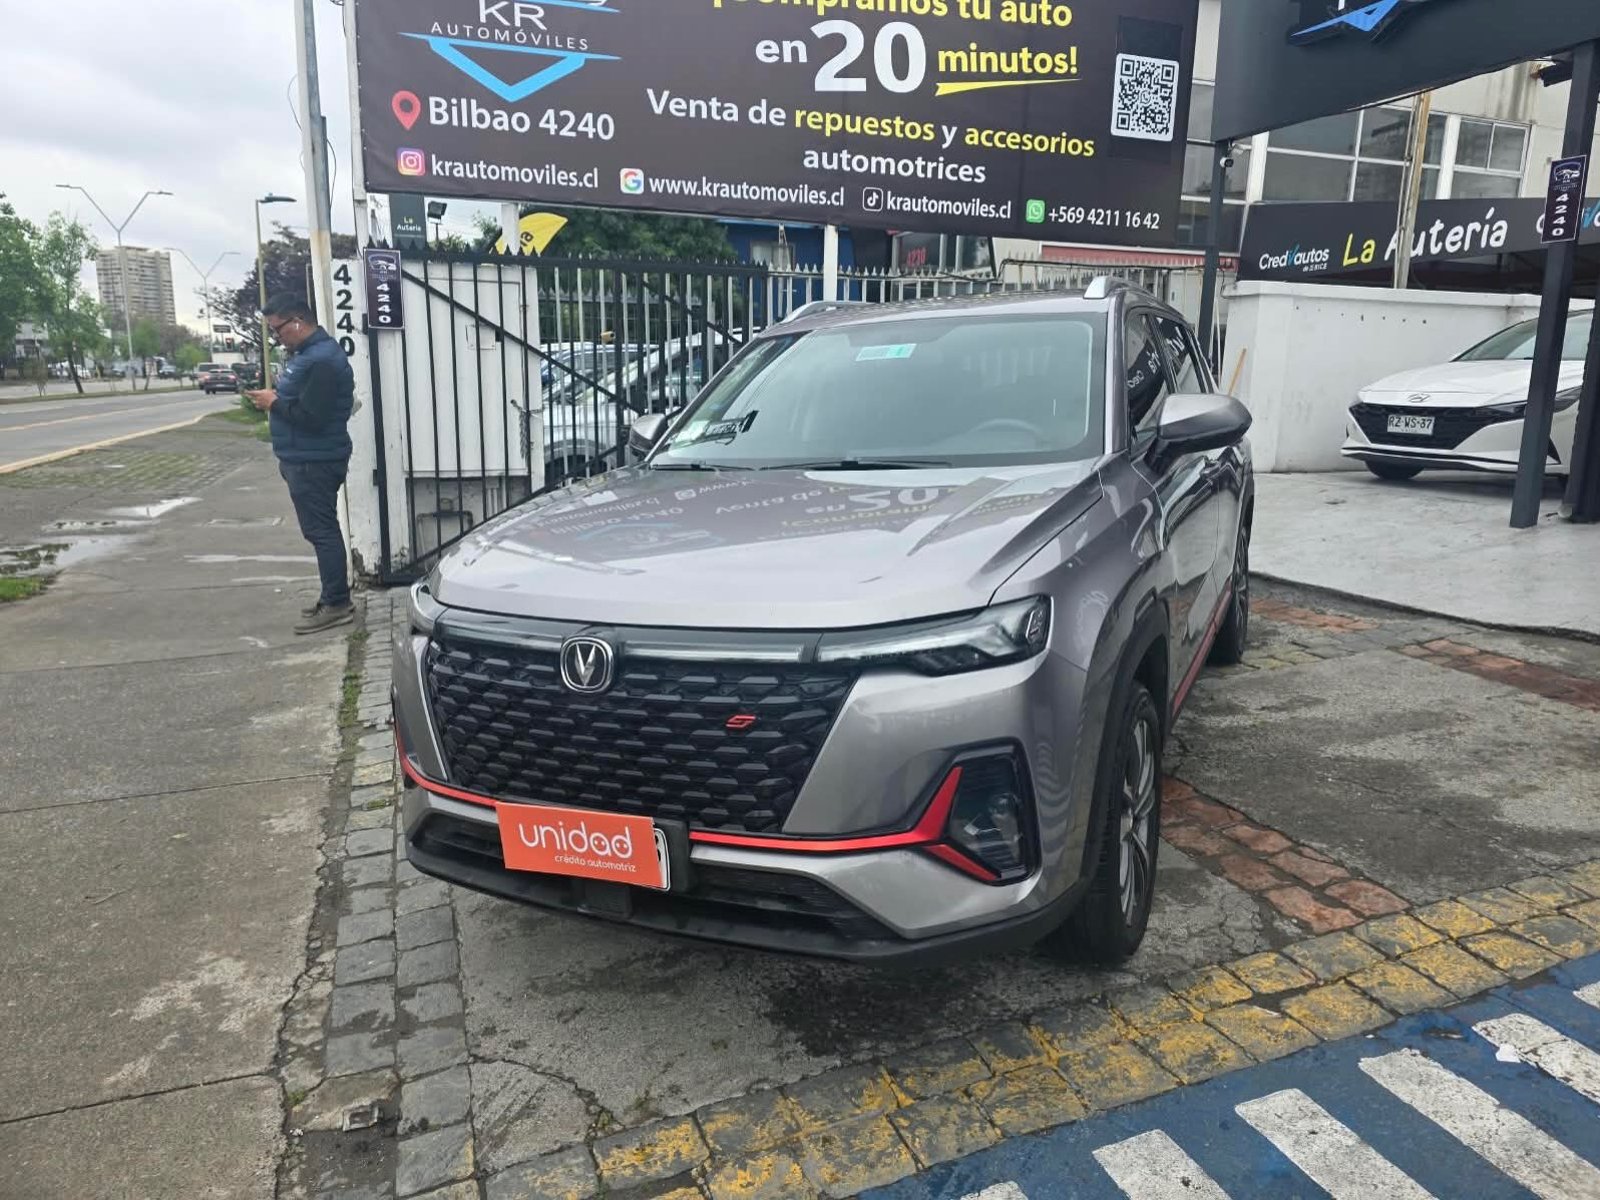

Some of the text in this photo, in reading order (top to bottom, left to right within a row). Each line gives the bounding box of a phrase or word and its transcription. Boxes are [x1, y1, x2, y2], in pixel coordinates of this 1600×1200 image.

[957, 0, 991, 20] tu
[1000, 0, 1073, 27] auto
[431, 22, 589, 50] AUTOMÓVILES
[755, 20, 1077, 93] en 20 minutos!
[428, 97, 615, 140] Bilbao 4240
[646, 88, 1095, 157] Venta de repuestos y accesorios
[431, 155, 599, 188] krautomoviles.cl
[802, 149, 986, 183] automotrices
[649, 176, 844, 206] www.krautomoviles.cl
[887, 192, 1011, 219] krautomoviles.cl
[1048, 206, 1161, 230] +569 4211 16 42
[1550, 193, 1570, 237] 4240
[1342, 233, 1376, 267] La
[333, 264, 355, 357] 4240
[377, 284, 391, 323] 4240
[519, 821, 633, 858] unidad
